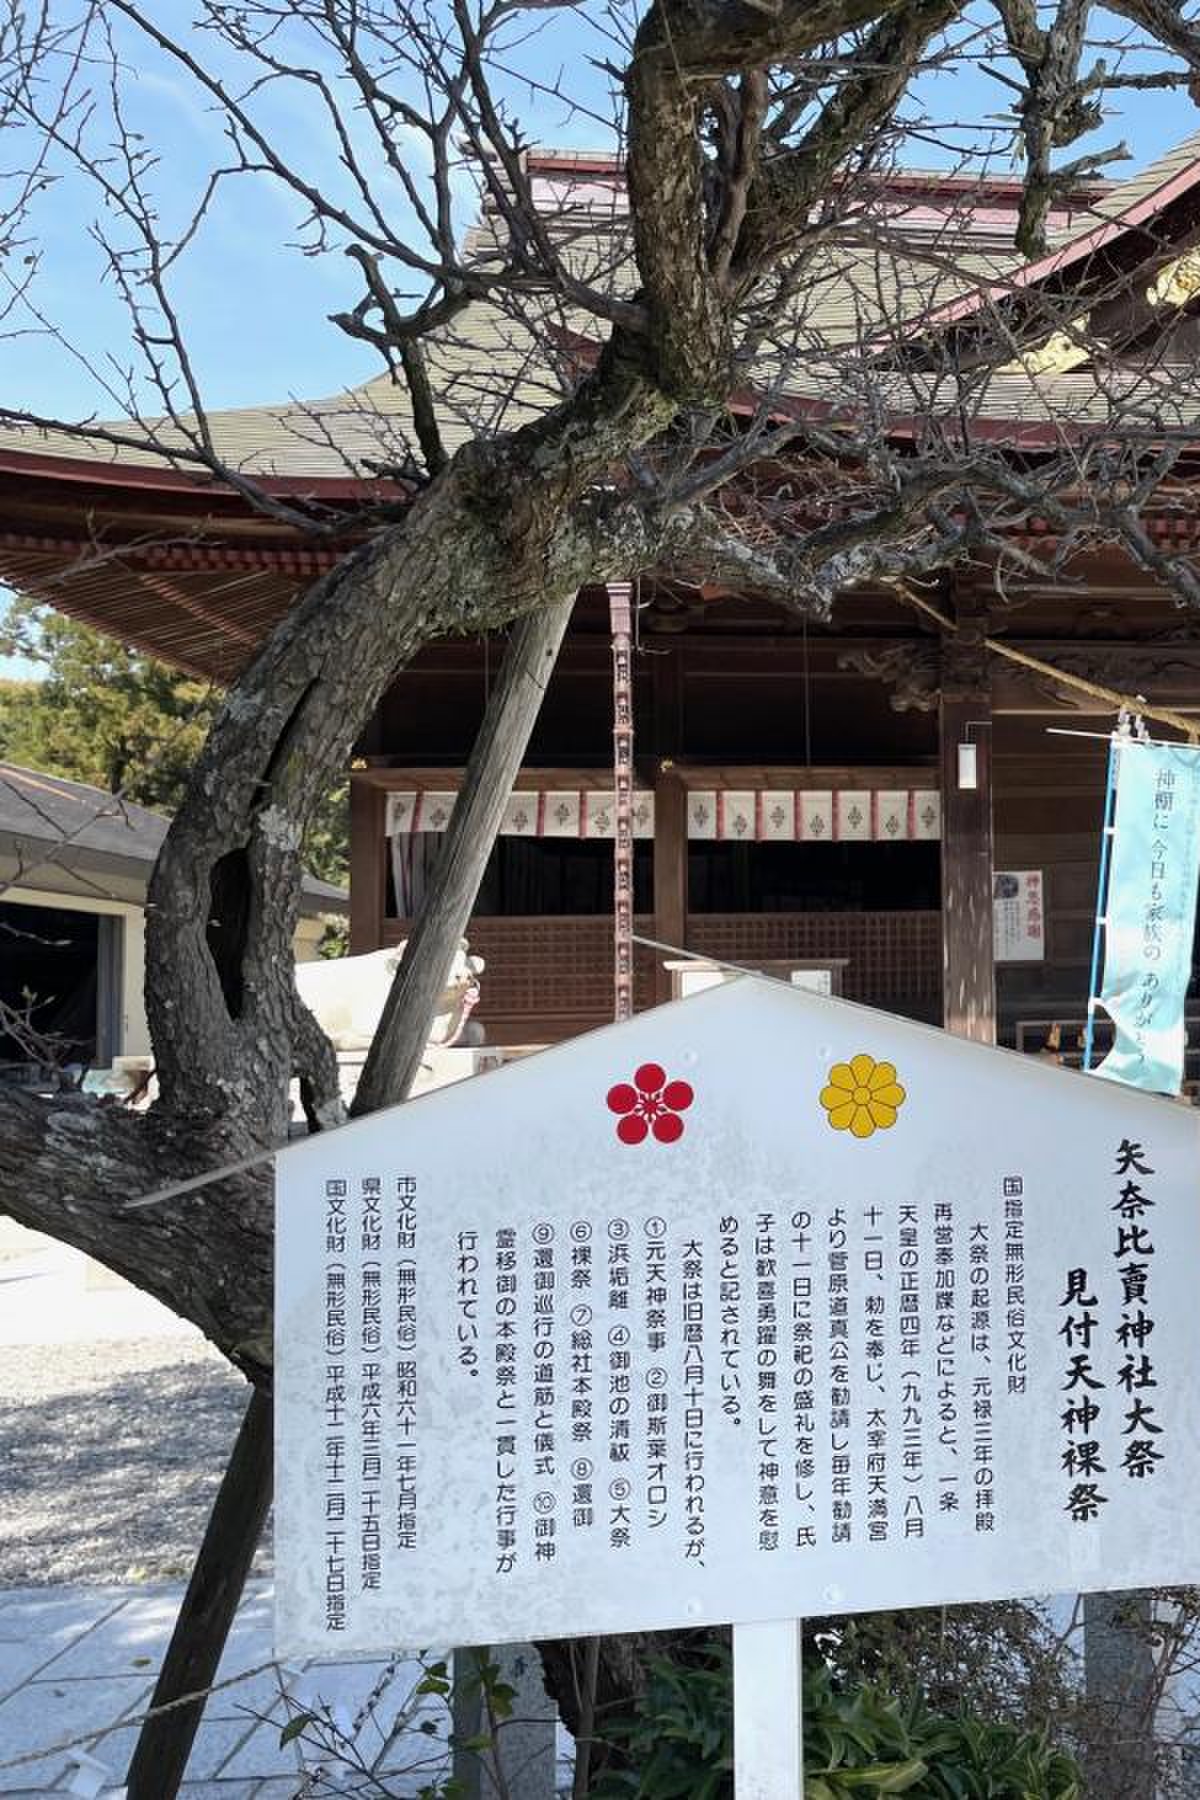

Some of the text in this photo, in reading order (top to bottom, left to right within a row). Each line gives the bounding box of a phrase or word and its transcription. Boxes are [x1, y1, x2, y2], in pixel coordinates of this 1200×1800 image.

[1002, 1175, 1028, 1395] 国指定無形民俗文化財
[1057, 1267, 1110, 1523] 見付天神裸祭
[1110, 1138, 1166, 1479] 矢奈比賣神社大祭
